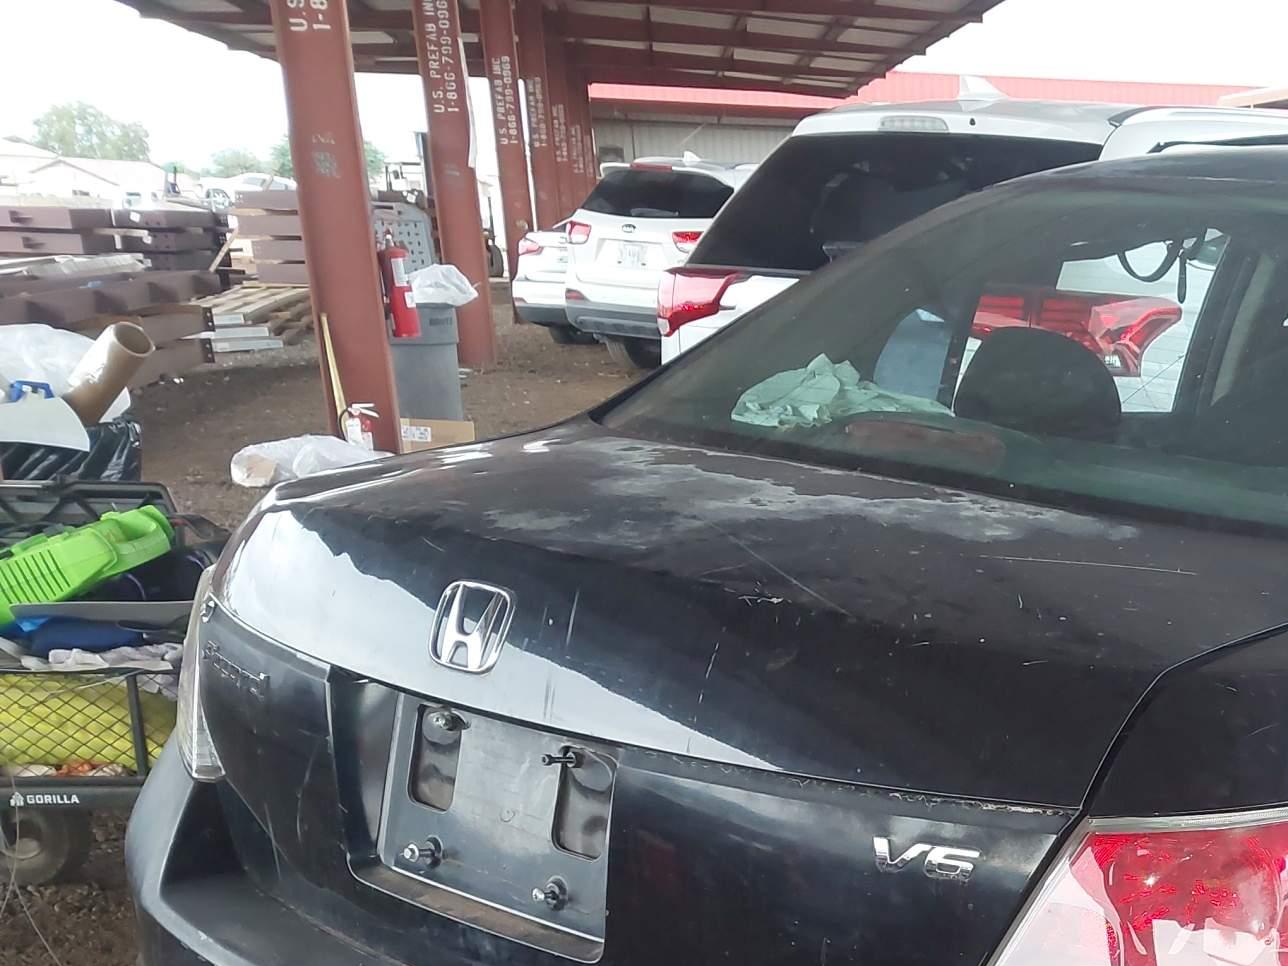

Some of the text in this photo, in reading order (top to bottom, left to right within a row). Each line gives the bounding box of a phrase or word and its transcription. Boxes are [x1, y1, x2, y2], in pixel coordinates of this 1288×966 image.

[425, 23, 441, 78] PREFAB
[494, 79, 506, 120] PREFAB
[26, 794, 80, 804] GORILLA
[873, 836, 982, 881] V6
